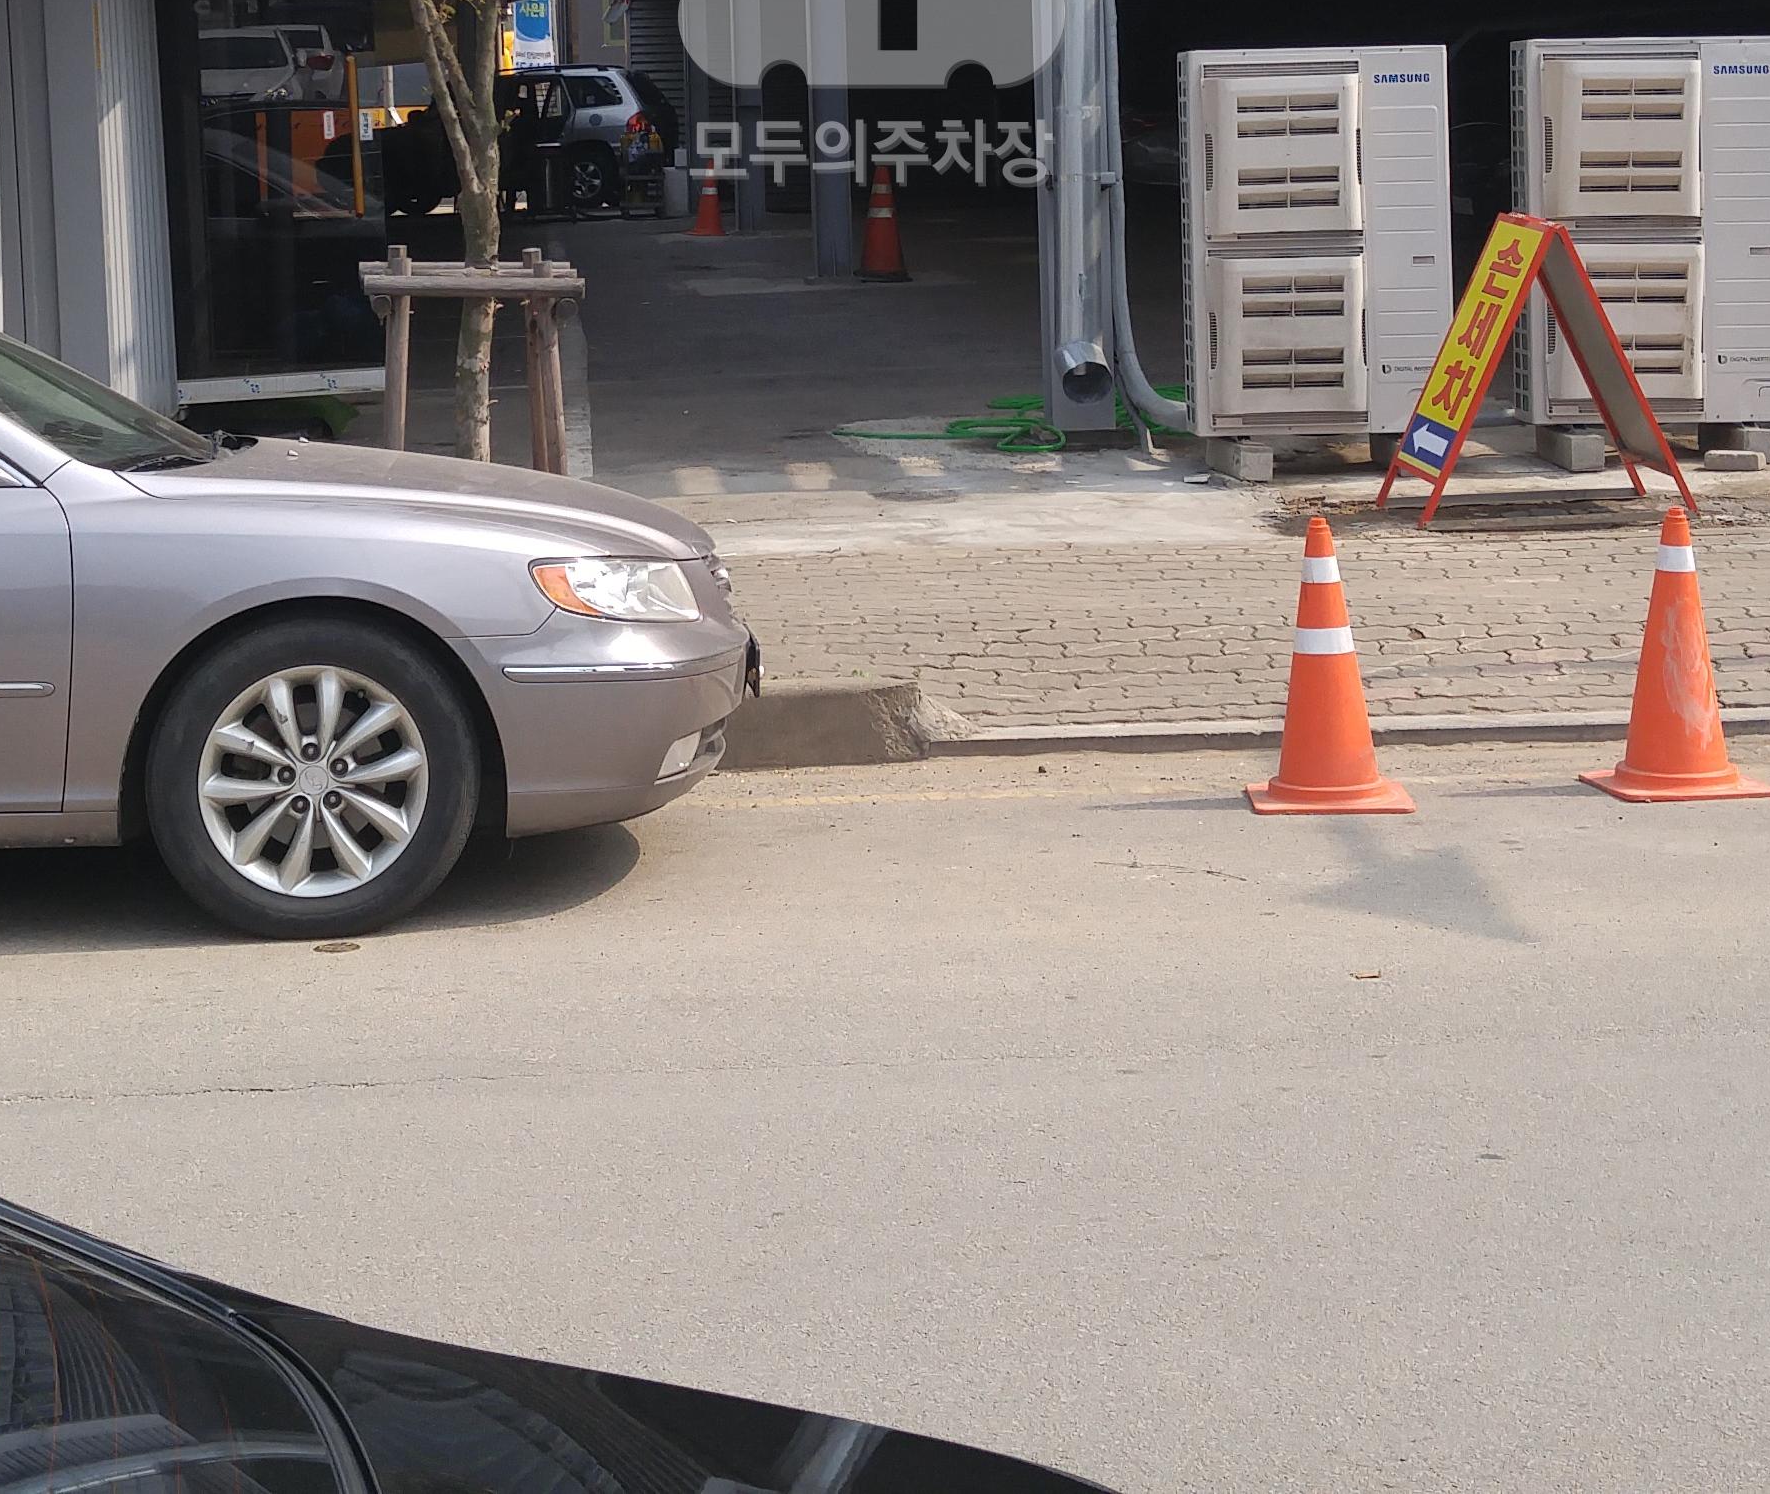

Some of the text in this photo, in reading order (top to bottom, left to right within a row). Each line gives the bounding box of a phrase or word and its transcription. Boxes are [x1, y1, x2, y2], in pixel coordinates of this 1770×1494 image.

[1713, 65, 1770, 75] SAMSUNG
[1373, 73, 1430, 84] SAMSUNG
[1432, 238, 1523, 421] 손세차
